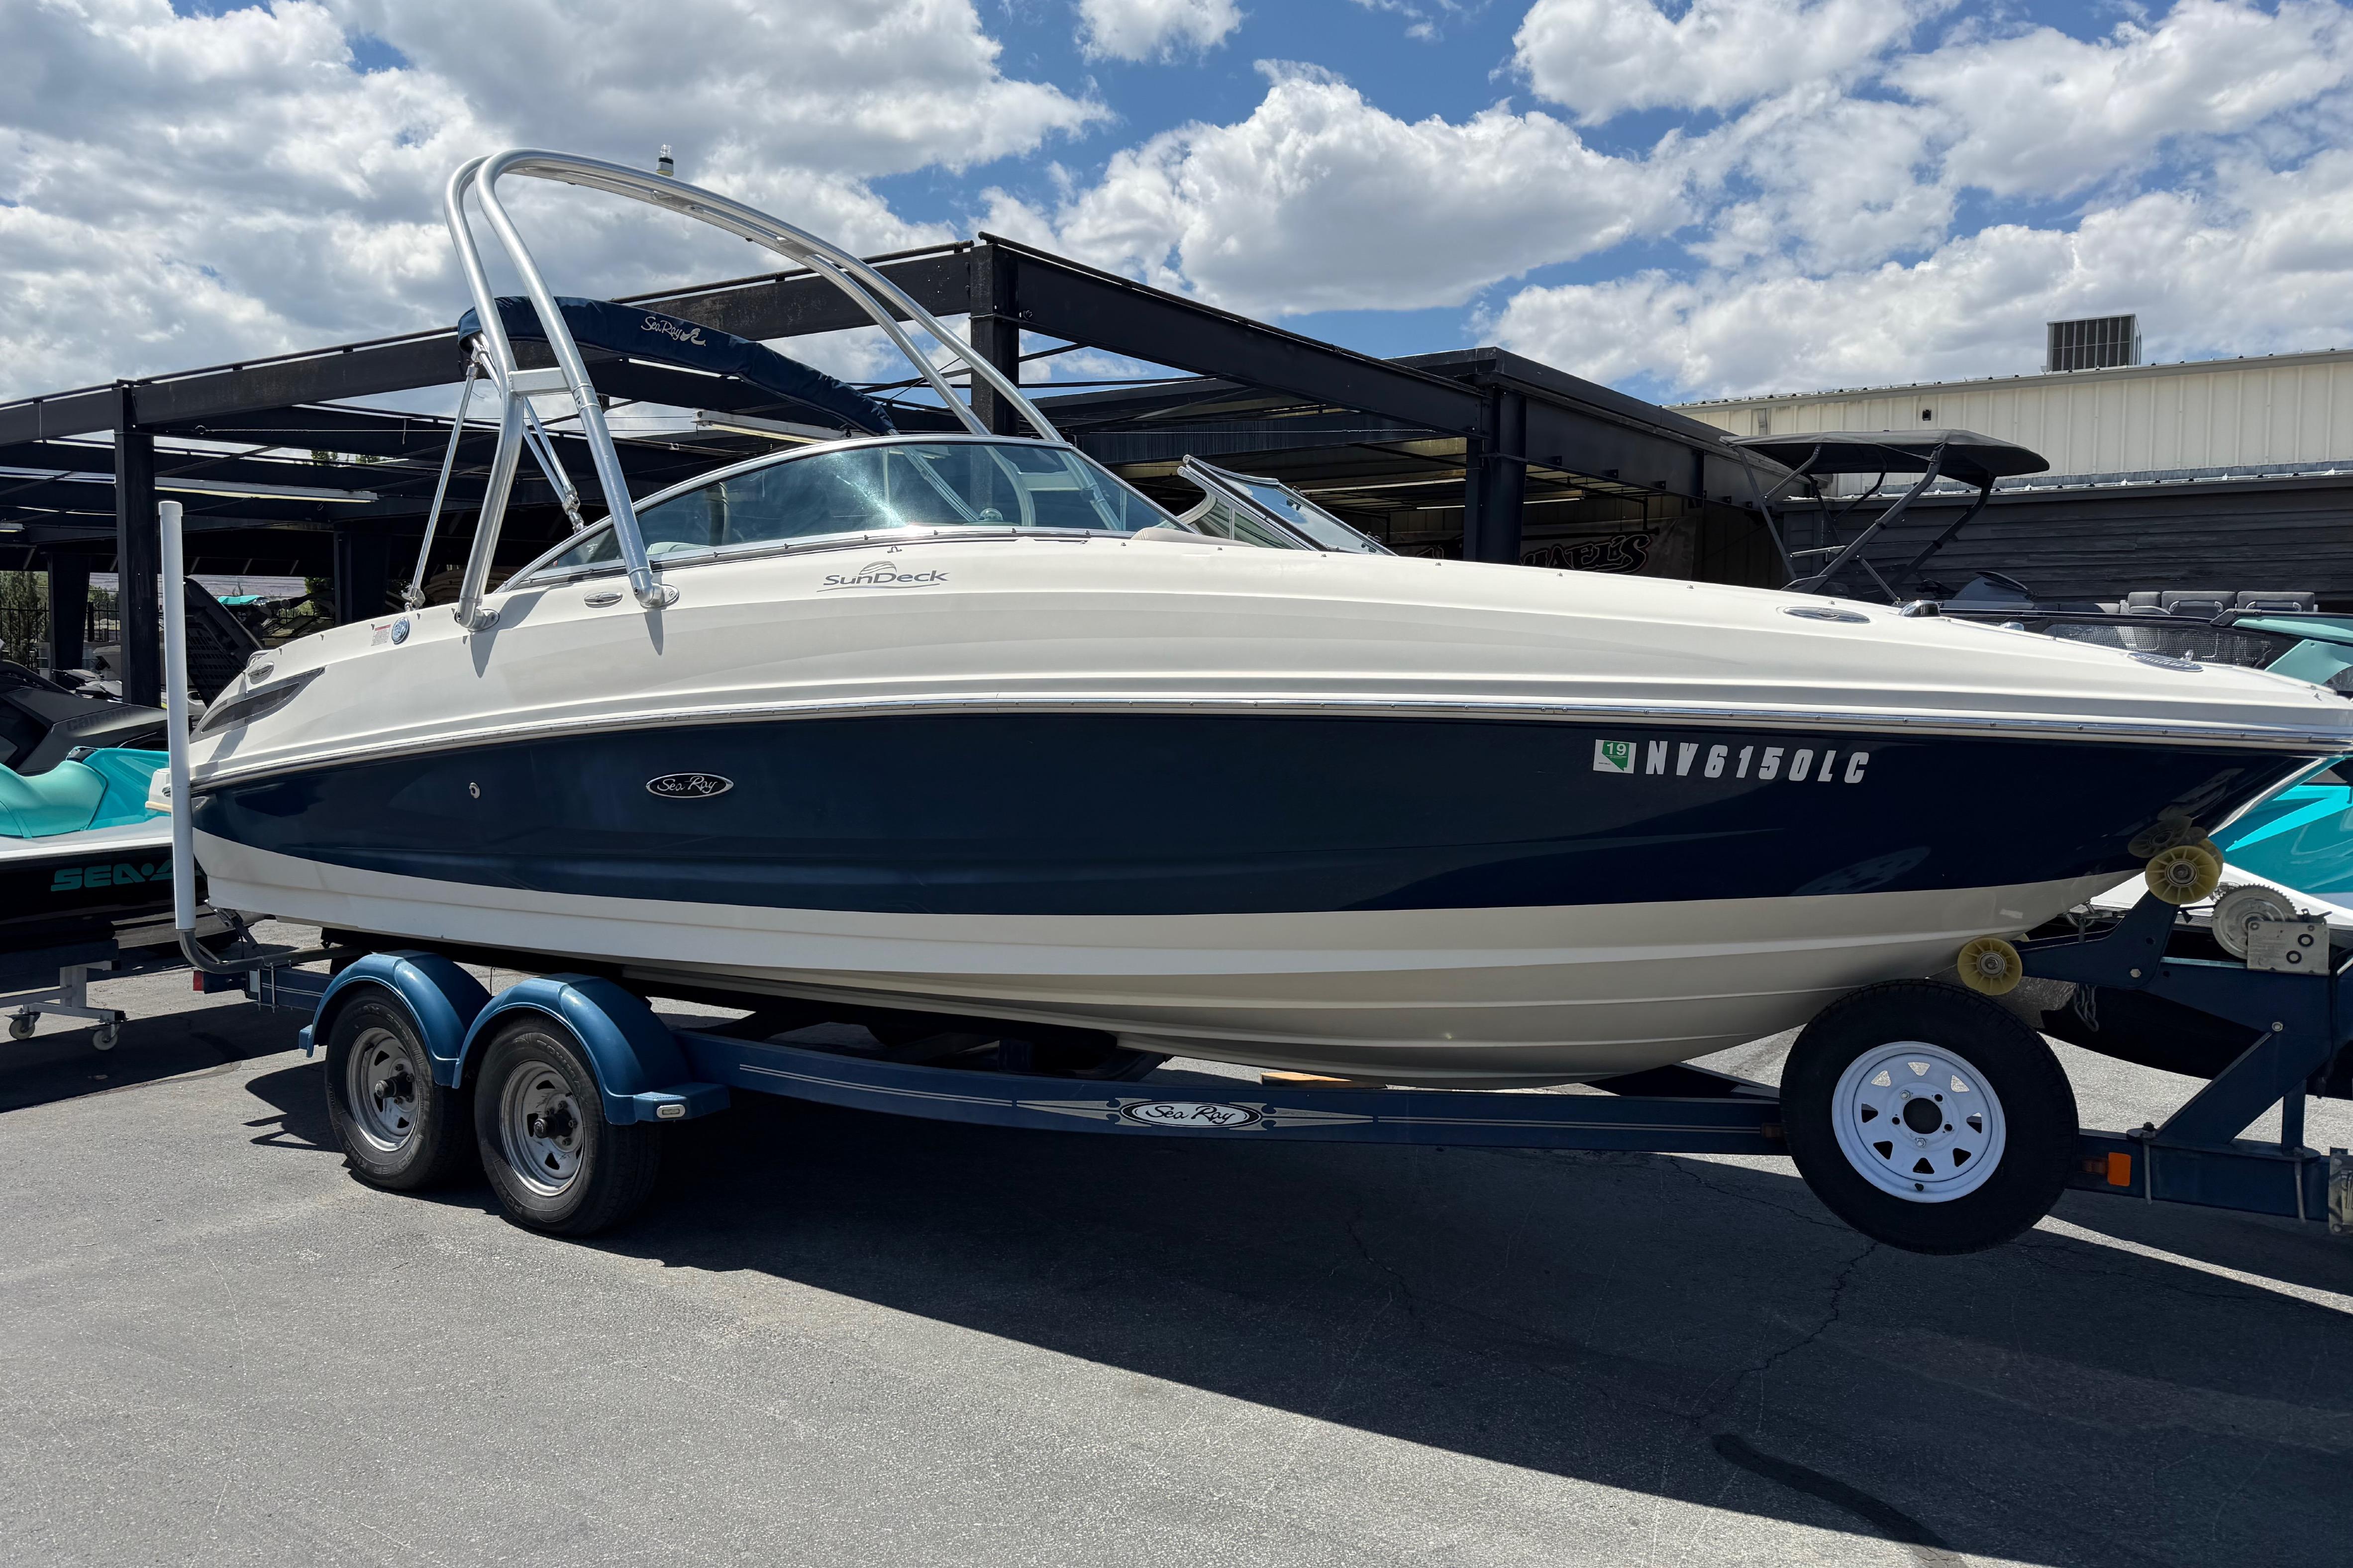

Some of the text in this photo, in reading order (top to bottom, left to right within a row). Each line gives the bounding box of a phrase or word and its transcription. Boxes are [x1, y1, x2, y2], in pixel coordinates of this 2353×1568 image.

[823, 570, 951, 586] SunDeck
[1607, 743, 1627, 756] 19
[657, 776, 718, 794] Sea Ray
[1145, 1105, 1236, 1124] Sea Ray
